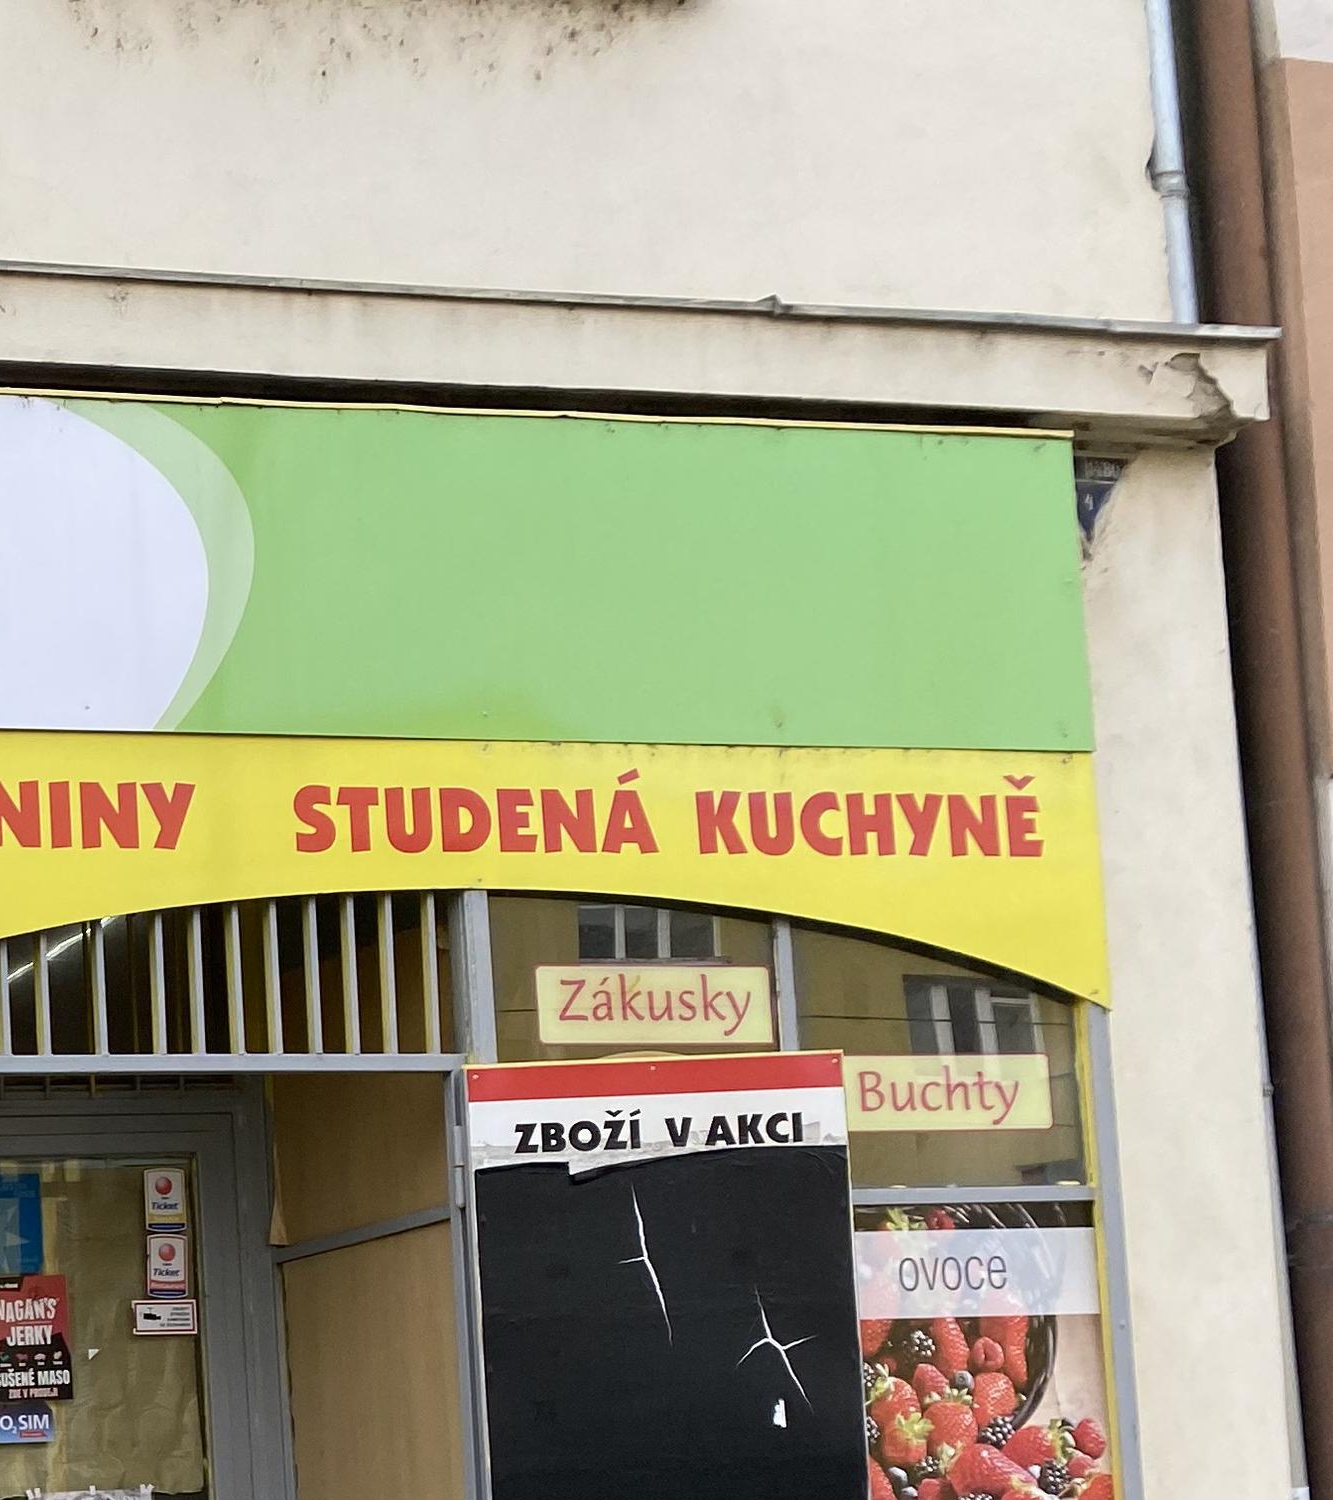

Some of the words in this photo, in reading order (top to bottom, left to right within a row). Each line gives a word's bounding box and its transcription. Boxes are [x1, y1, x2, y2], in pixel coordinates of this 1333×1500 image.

[293, 770, 659, 855] STUDENÁ
[695, 776, 1044, 858] KUCHYNĚ
[559, 974, 751, 1036] Zákusky
[858, 1069, 1019, 1125] Buchty
[514, 1109, 642, 1154] ZBOŽÍ
[664, 1116, 692, 1148] V
[705, 1111, 804, 1146] AKCI
[151, 1200, 179, 1211] Ticket
[152, 1267, 181, 1278] Ticket
[898, 1255, 1008, 1293] ovoce
[6, 1325, 53, 1347] JERKY
[37, 1369, 71, 1386] MASO
[18, 1413, 50, 1431] SIM
